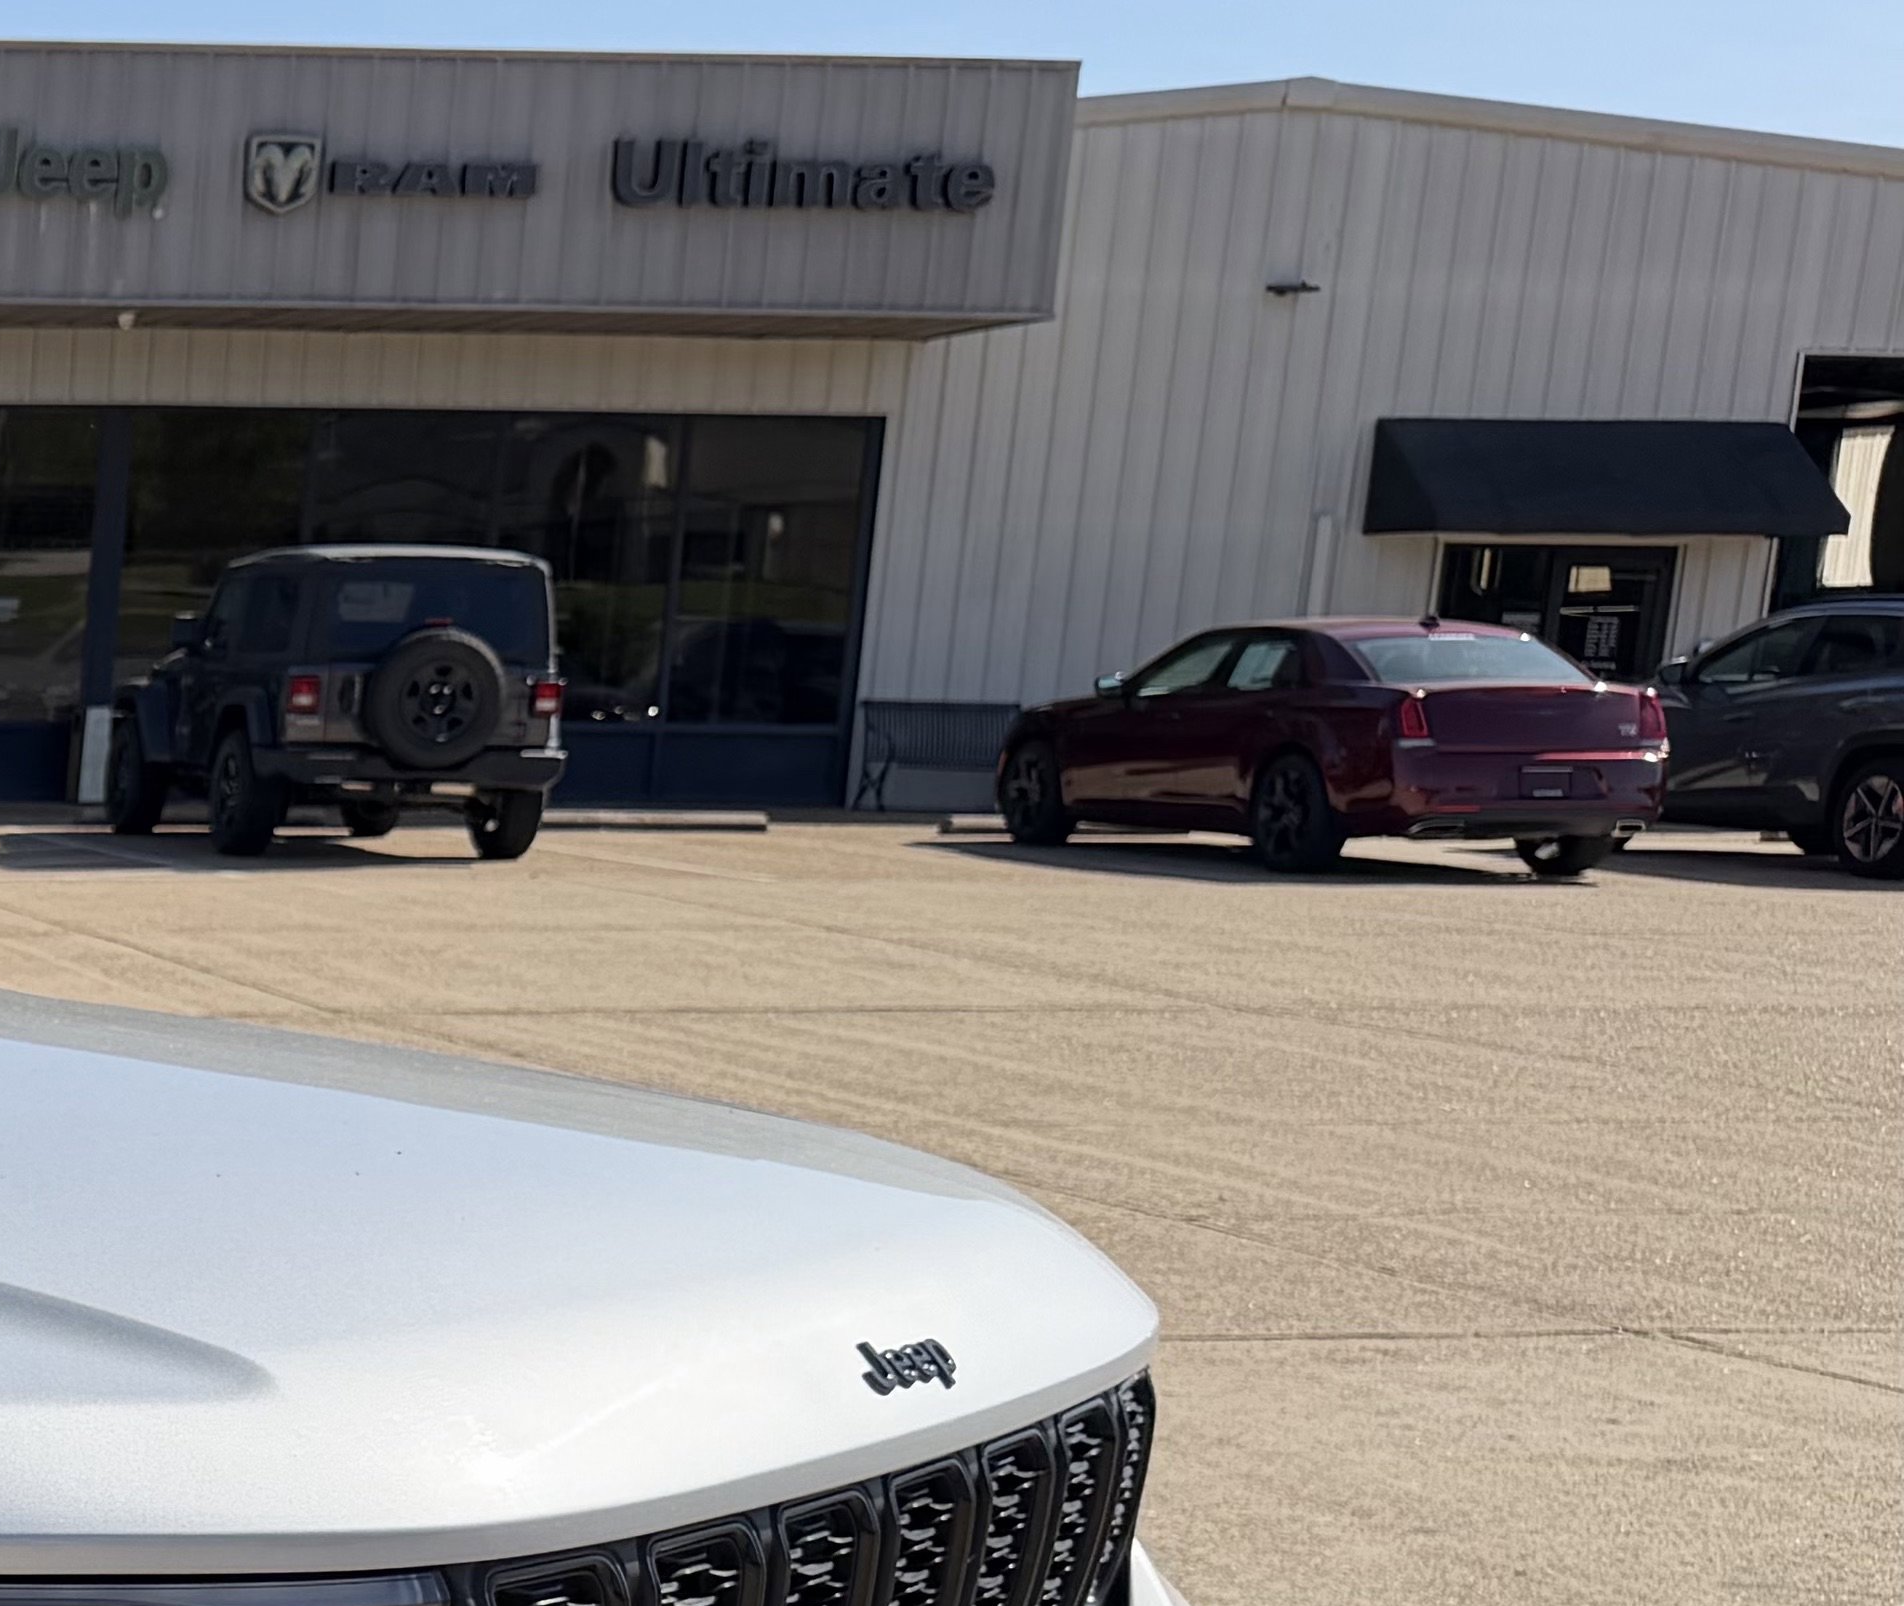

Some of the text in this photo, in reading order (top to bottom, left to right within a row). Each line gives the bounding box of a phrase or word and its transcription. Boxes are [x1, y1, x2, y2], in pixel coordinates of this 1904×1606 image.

[328, 161, 538, 198] RAM
[610, 138, 996, 213] Ultimate
[856, 1338, 957, 1397] Jeep
